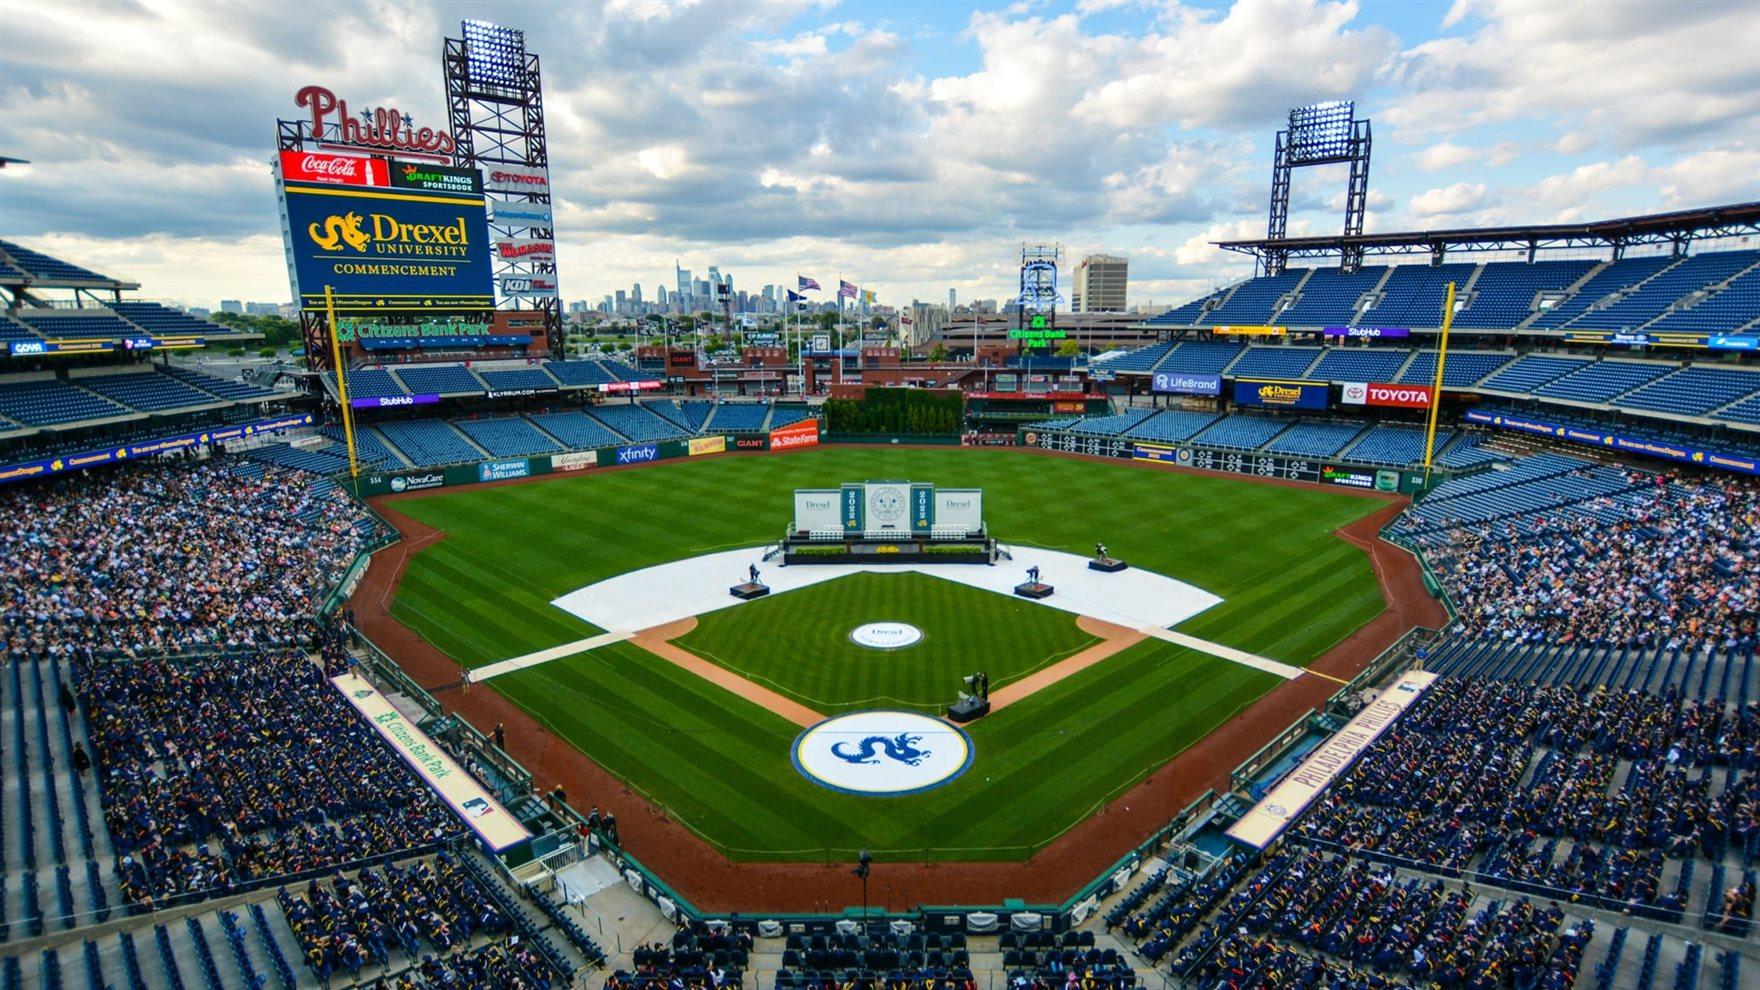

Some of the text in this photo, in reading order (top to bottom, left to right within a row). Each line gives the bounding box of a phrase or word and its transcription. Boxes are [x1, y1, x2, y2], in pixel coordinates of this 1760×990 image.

[294, 85, 456, 153] Phillies
[301, 154, 358, 177] Coca-Cola
[405, 171, 472, 185] DRAFTKINGS
[505, 174, 547, 185] TOYOTA
[422, 181, 473, 192] SPORTSBOOK
[370, 213, 469, 245] Drexel
[376, 243, 467, 256] UNIVERSITY
[333, 263, 456, 276] COMMENCEMENT
[504, 279, 531, 292] KDI
[357, 321, 490, 339] Citizens Bank Park
[1009, 329, 1066, 339] Citizens Bank
[1347, 328, 1381, 337] StubHub
[15, 343, 42, 352] GOYA
[1028, 339, 1047, 347] Park
[1170, 378, 1217, 390] LifeBrand
[1274, 386, 1302, 396] Drexel
[1370, 388, 1428, 403] TOYOTA
[379, 397, 413, 406] StubHub
[737, 439, 763, 447] GIANT
[620, 447, 656, 462] xfinity
[492, 461, 525, 471] SHERWIN
[406, 473, 444, 485] NovaCare
[806, 501, 831, 509] Drexel
[946, 500, 971, 508] Drexel
[1293, 700, 1402, 789] PHILADELPHIA PHILLIES
[387, 722, 453, 780] Citizens Bank Park
